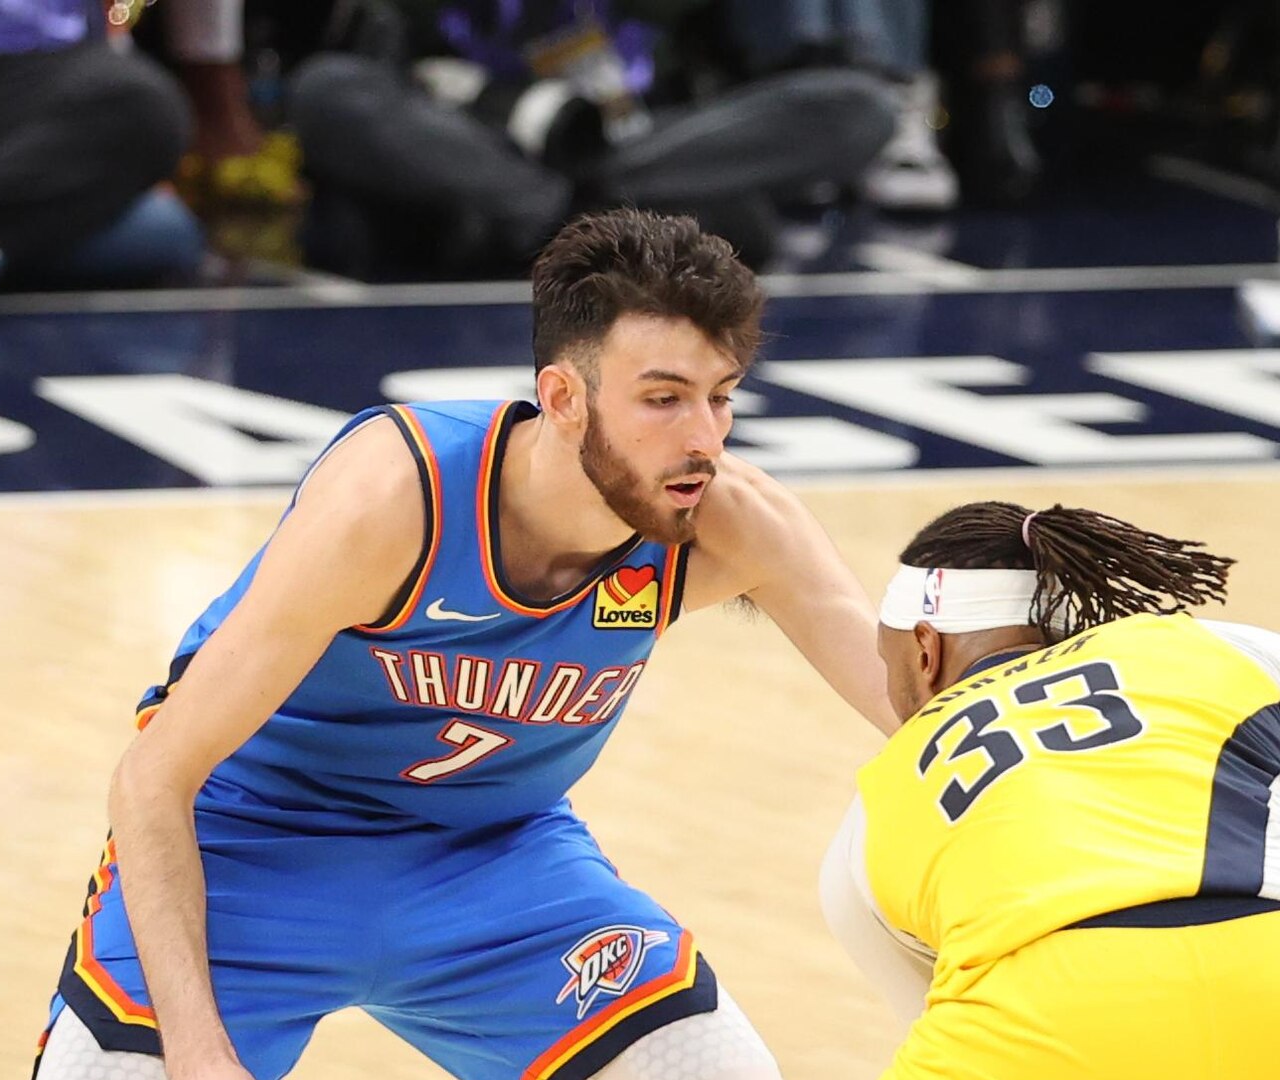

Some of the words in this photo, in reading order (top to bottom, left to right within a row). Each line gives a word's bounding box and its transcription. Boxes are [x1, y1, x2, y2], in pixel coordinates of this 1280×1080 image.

[370, 646, 647, 727] THUNDER
[399, 717, 516, 784] 7
[917, 658, 1147, 826] 33
[580, 934, 628, 999] OKC
